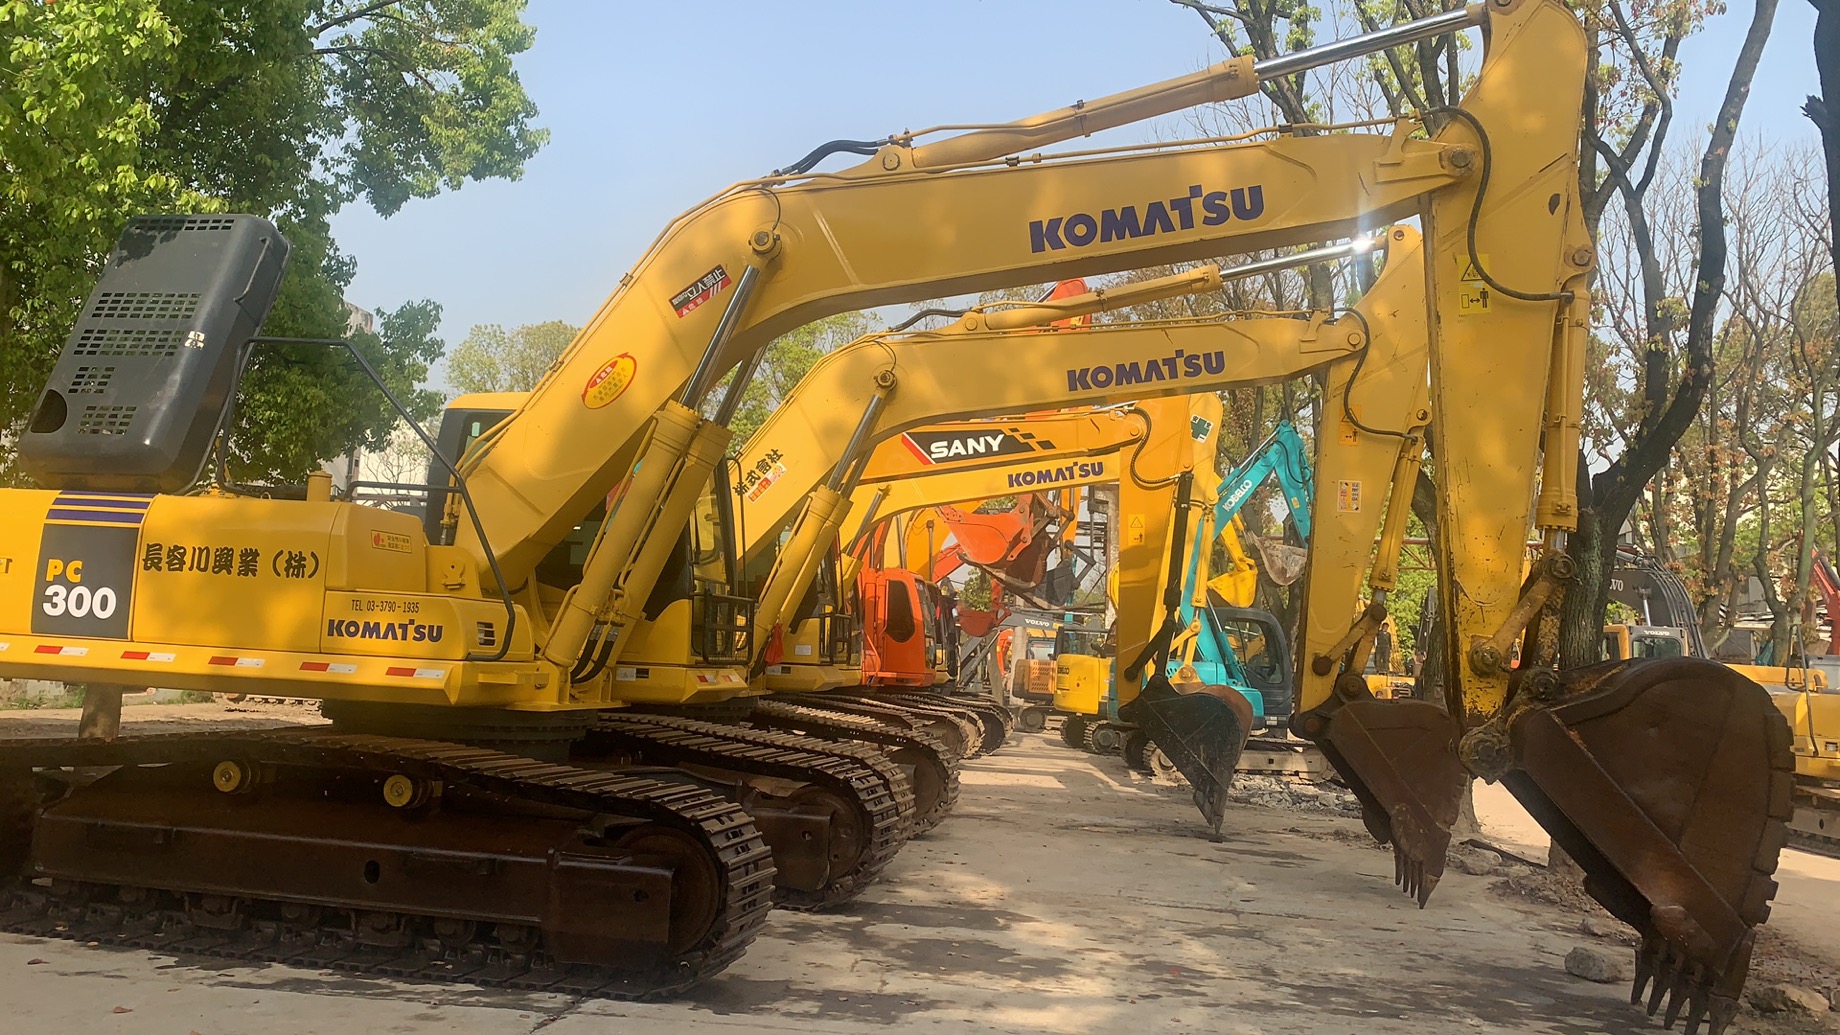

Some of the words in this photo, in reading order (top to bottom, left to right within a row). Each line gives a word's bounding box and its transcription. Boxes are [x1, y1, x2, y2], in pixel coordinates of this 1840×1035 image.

[1029, 184, 1265, 253] KOMATSU
[1067, 349, 1225, 392] KOMATSU
[929, 433, 1006, 459] SANY
[1007, 461, 1104, 488] KOMATSU
[1222, 479, 1253, 512] KOBELCO
[45, 558, 83, 583] PC
[42, 584, 117, 620] 300
[351, 599, 363, 611] TEL
[366, 600, 420, 613] 03-3790-1935
[327, 618, 444, 643] KOMATSU
[1024, 618, 1050, 627] VOLVO
